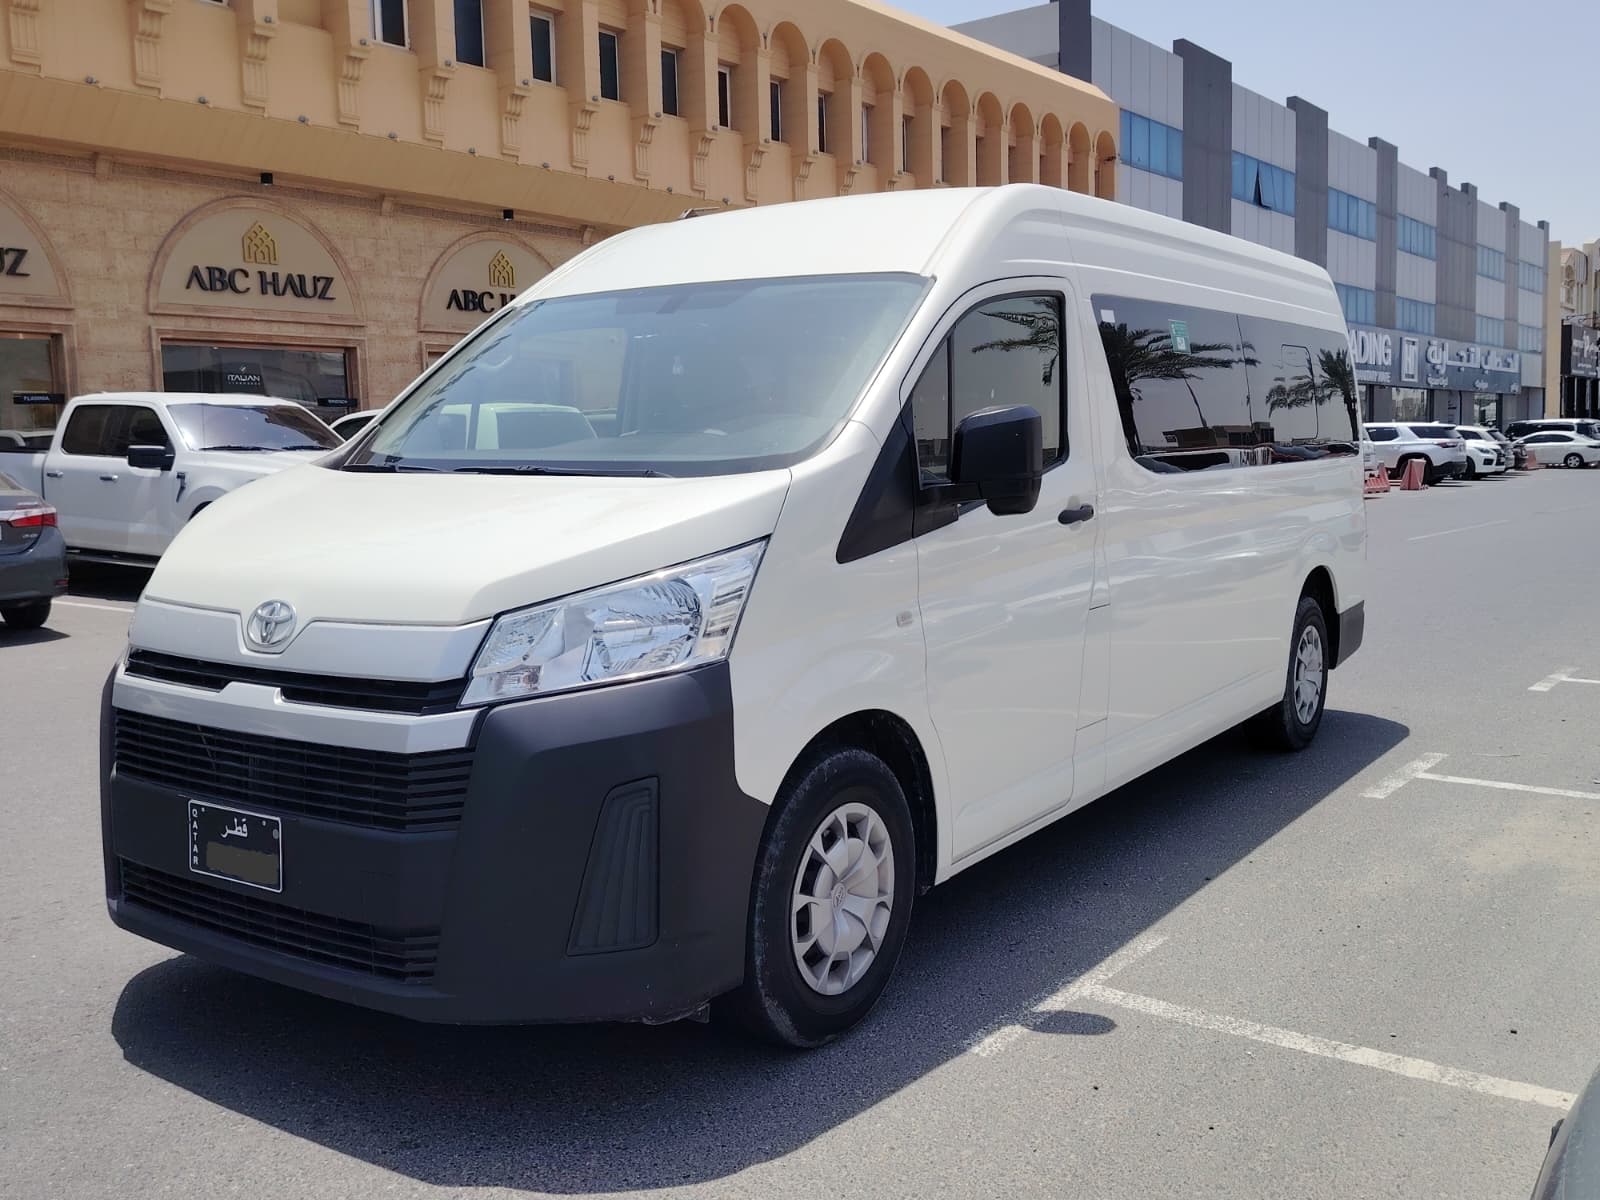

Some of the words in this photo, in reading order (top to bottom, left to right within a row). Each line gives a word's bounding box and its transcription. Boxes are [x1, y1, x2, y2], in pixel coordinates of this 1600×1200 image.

[0, 247, 31, 277] Z
[185, 264, 251, 295] ABC
[257, 270, 337, 301] HAUZ
[446, 288, 495, 314] ABC
[191, 808, 199, 866] QATAR
[221, 816, 248, 838] قطر
